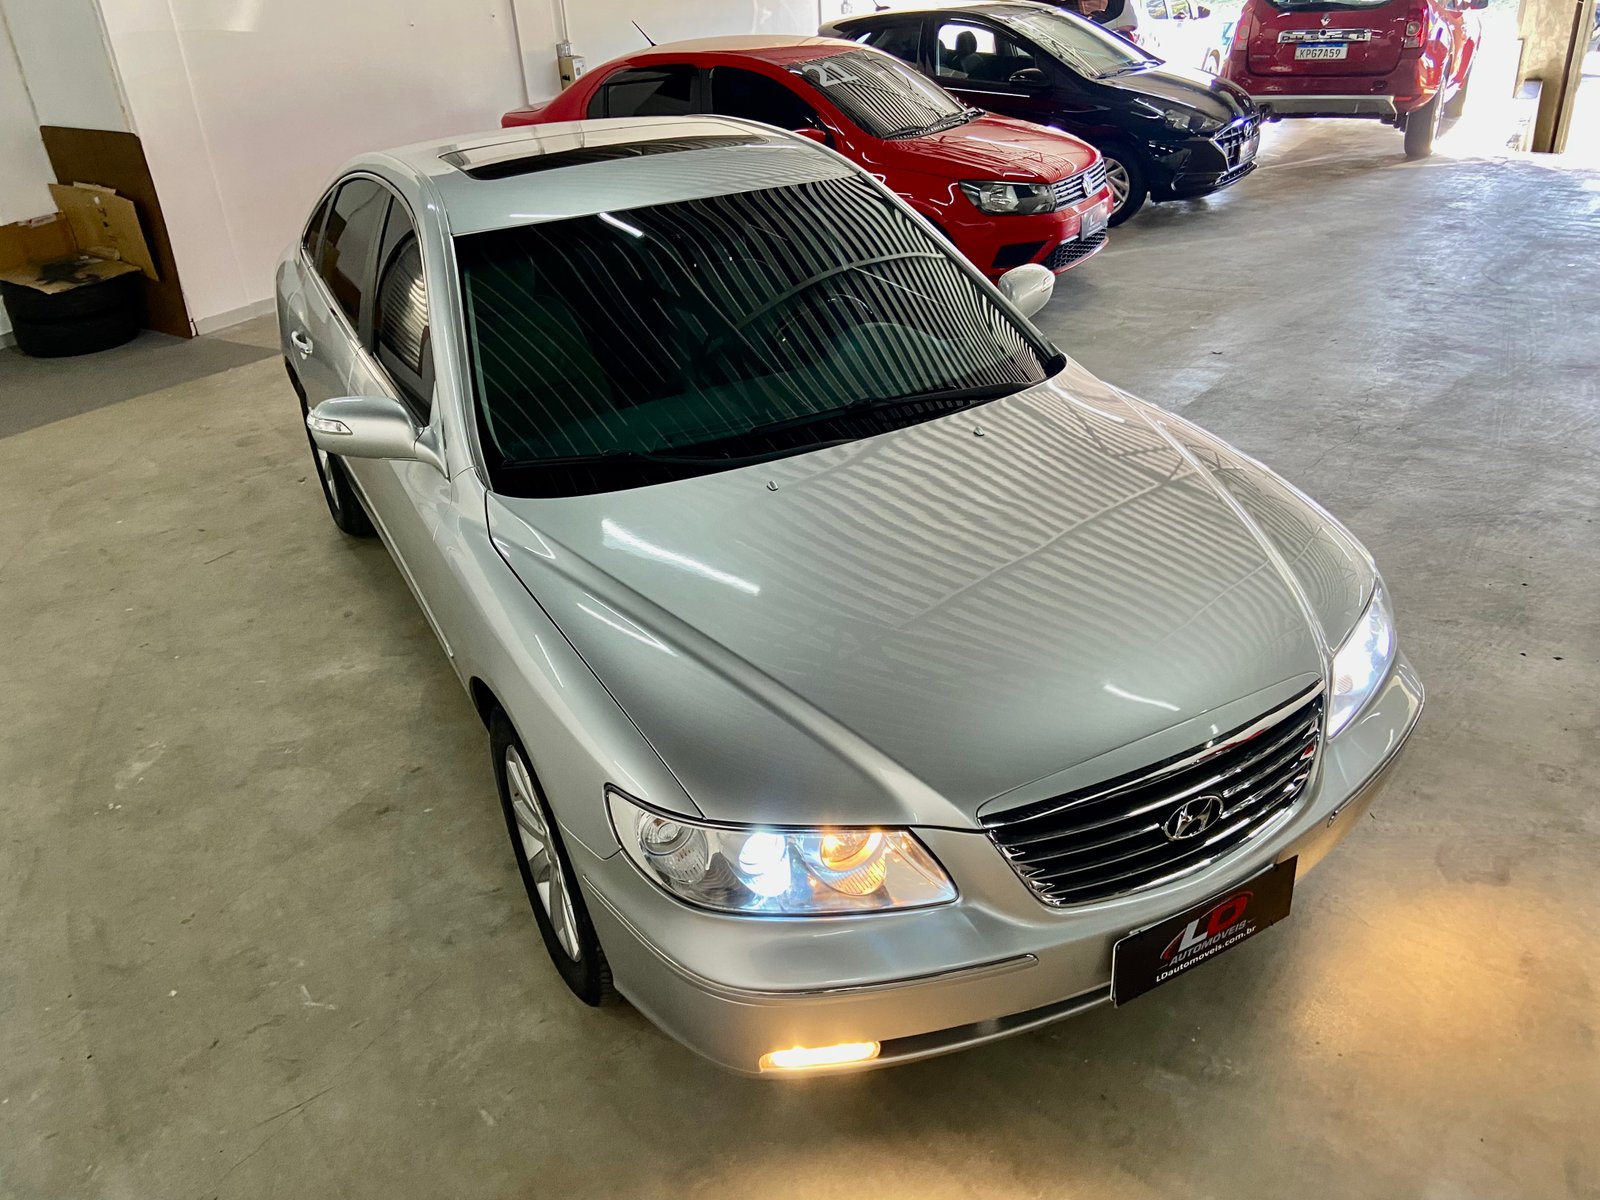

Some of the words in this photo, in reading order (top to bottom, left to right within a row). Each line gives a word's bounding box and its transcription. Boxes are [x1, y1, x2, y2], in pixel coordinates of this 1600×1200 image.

[1299, 48, 1341, 58] KPG7A59
[1178, 896, 1248, 952] LD
[1156, 925, 1256, 982] LDautomoveis.com.br
